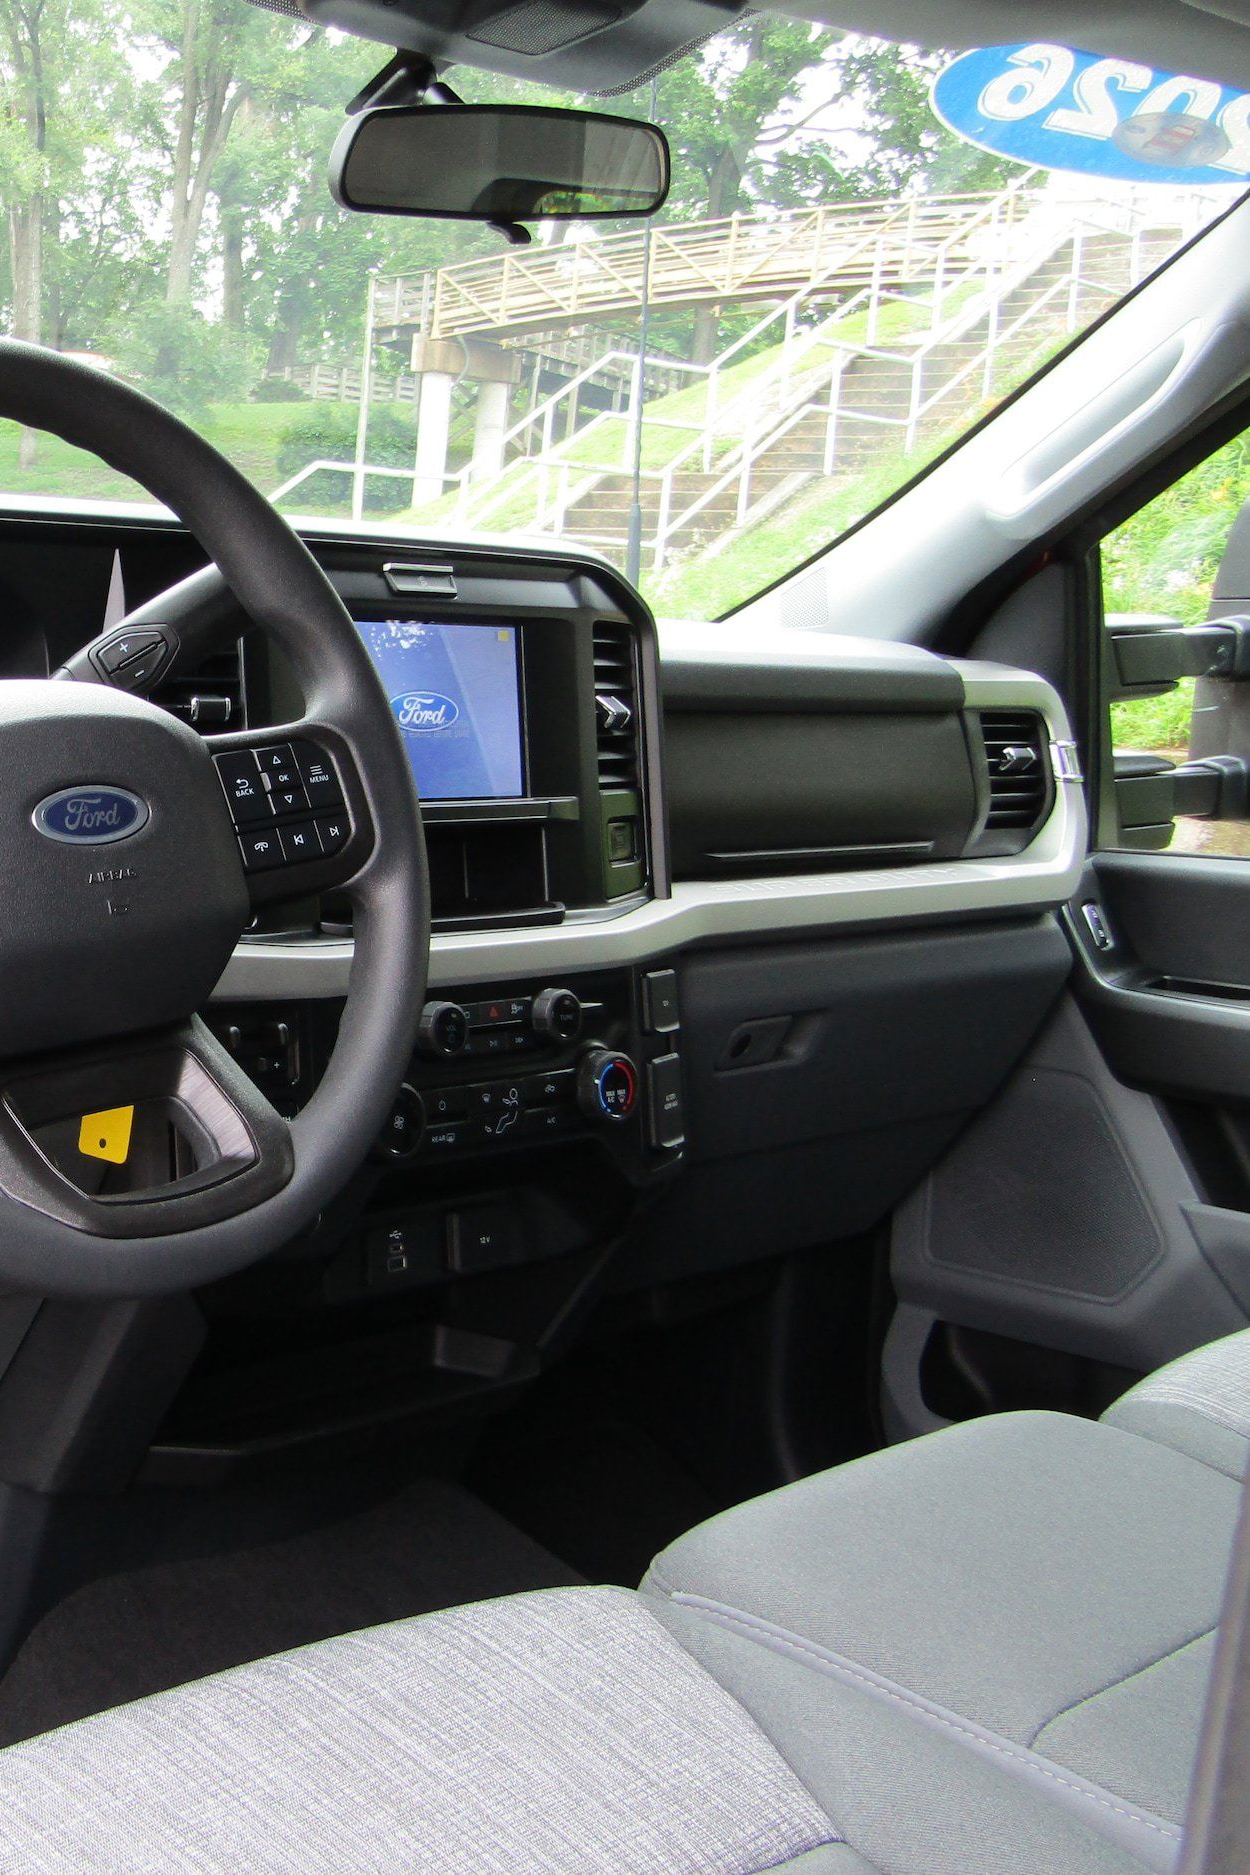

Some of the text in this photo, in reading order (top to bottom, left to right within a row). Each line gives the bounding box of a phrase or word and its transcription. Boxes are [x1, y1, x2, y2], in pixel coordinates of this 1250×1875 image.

[398, 696, 446, 724] Ford
[278, 773, 289, 782] OK
[309, 775, 329, 784] MENU
[235, 789, 254, 798] BACK
[64, 797, 120, 831] Ford
